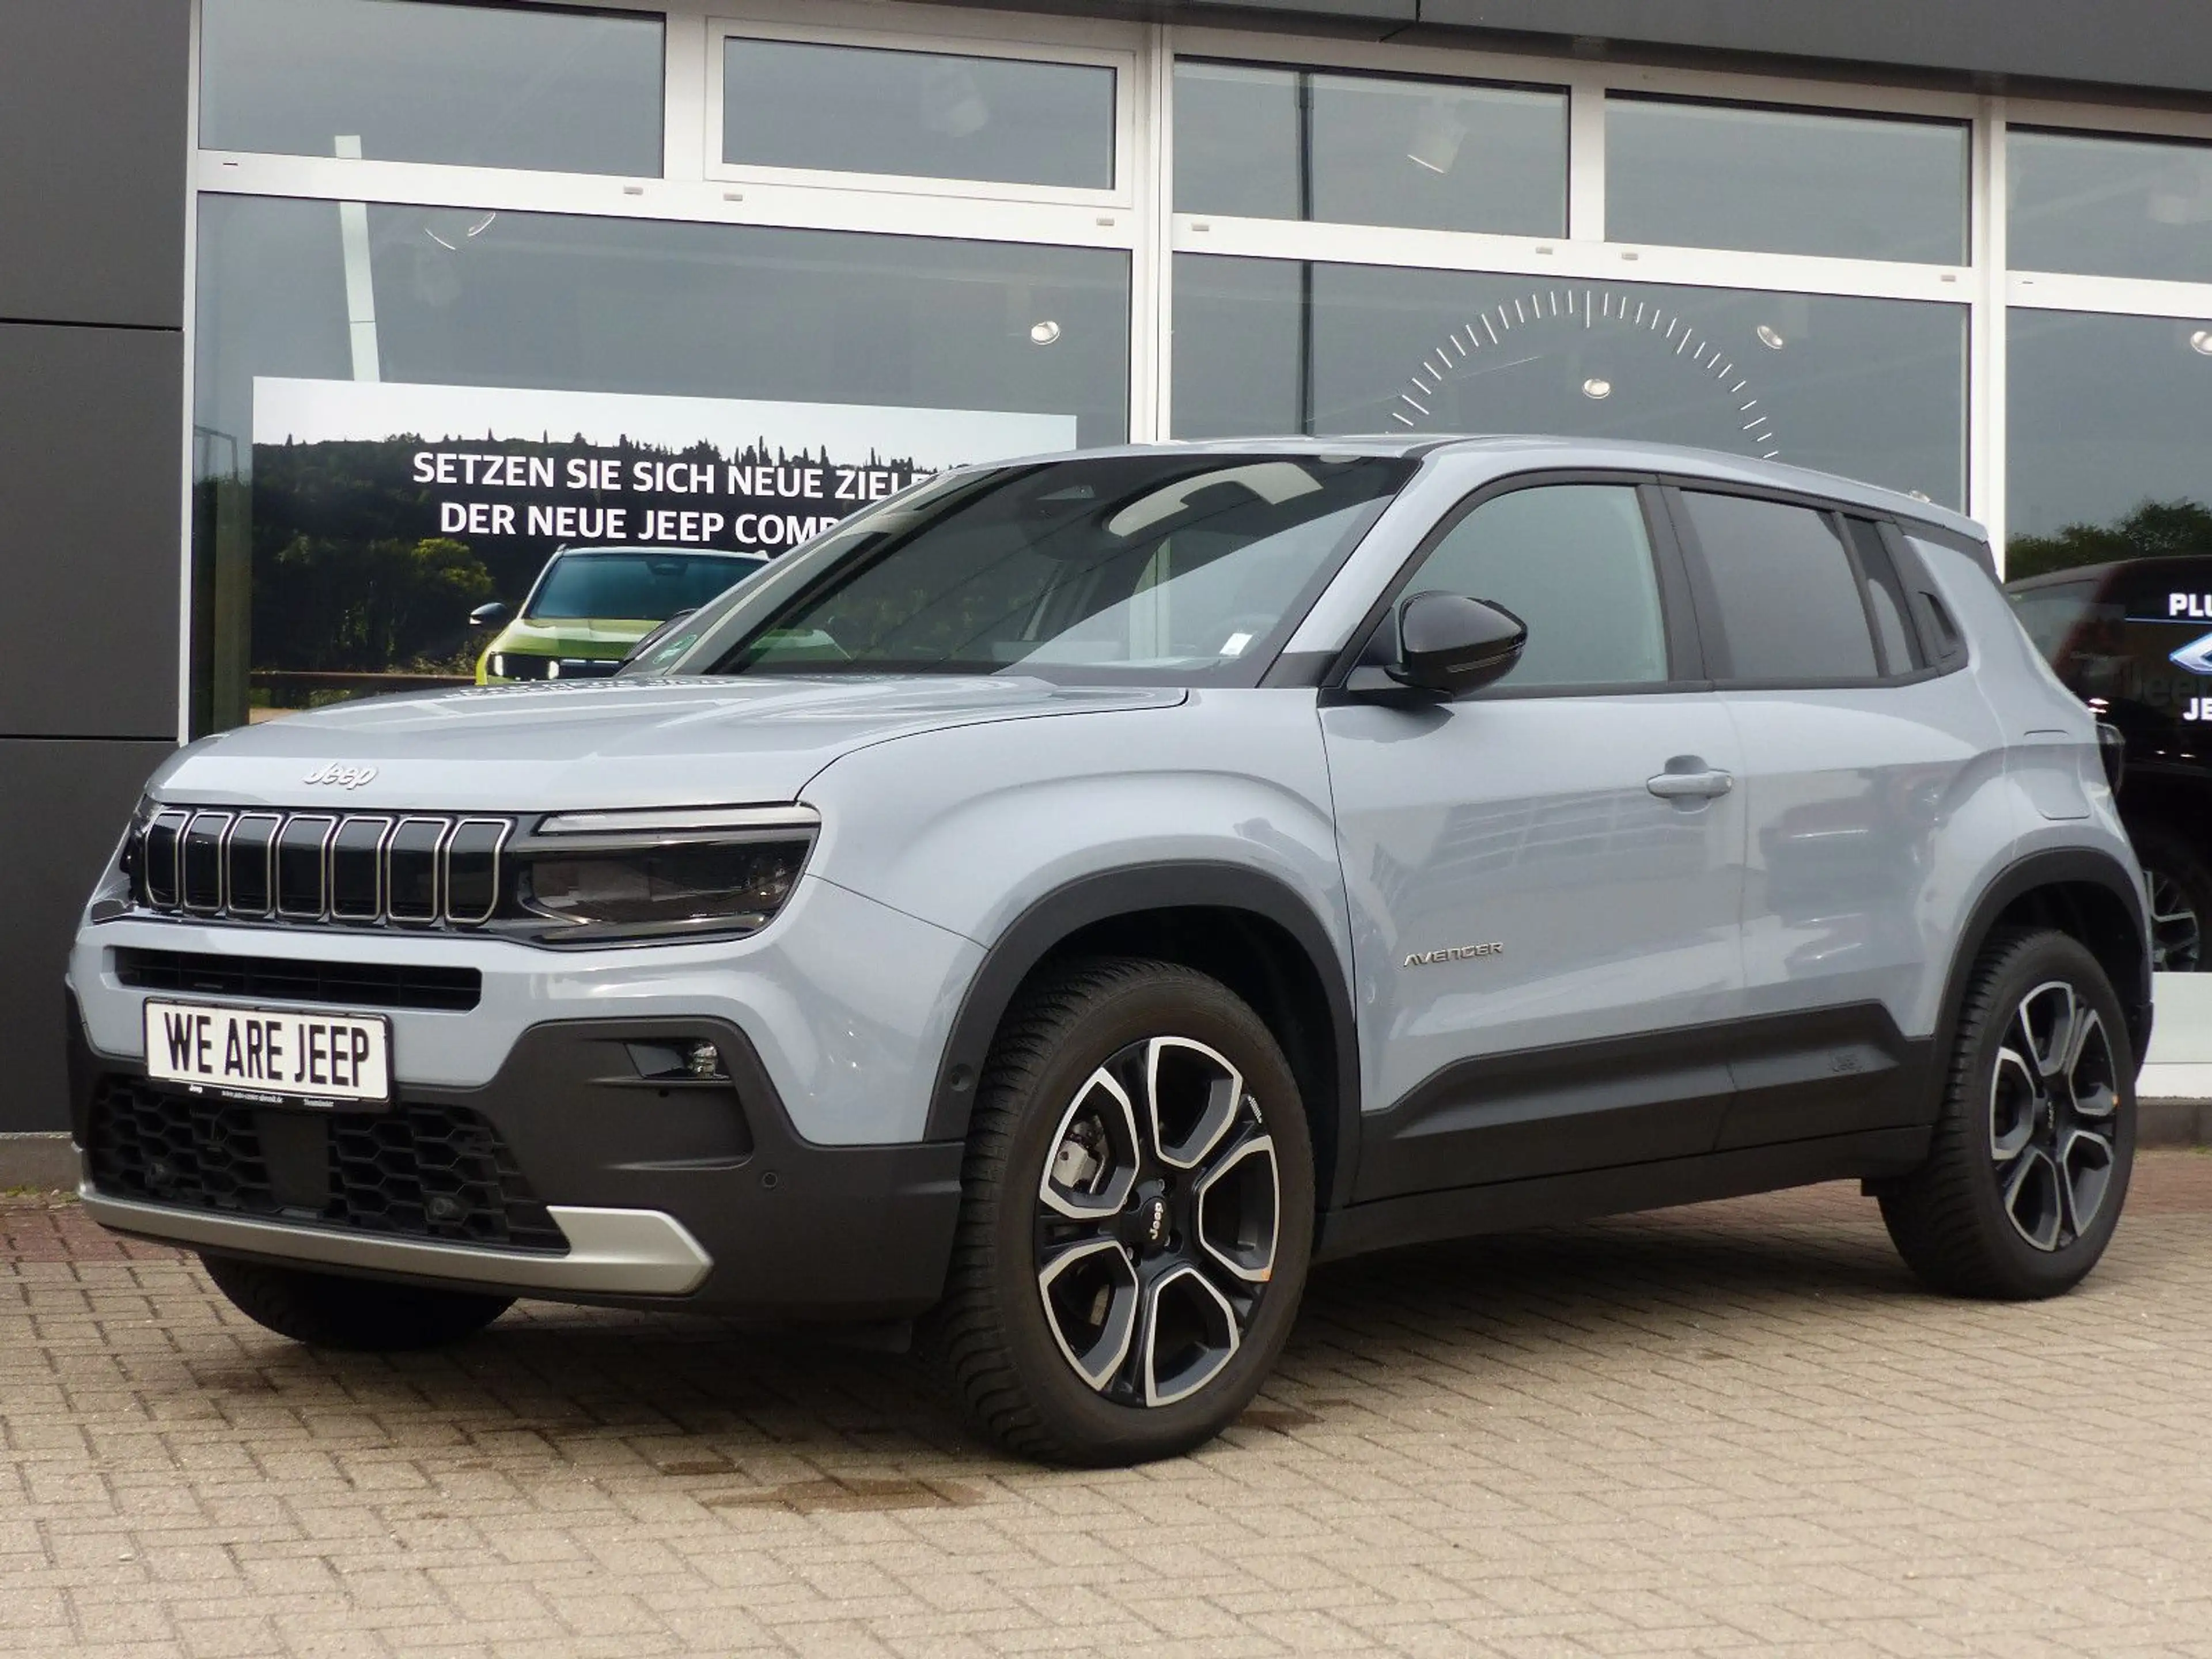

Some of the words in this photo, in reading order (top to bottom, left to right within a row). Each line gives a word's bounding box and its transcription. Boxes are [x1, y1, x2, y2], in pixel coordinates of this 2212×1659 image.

[413, 452, 554, 488] SETZEN
[566, 459, 622, 490] SIE
[632, 461, 715, 494] SICH
[728, 465, 823, 499] NEUE
[441, 502, 516, 535] DER
[528, 506, 627, 539] NEUE
[638, 510, 724, 542] JEEP
[302, 762, 378, 790] Jeep
[1403, 942, 1504, 968] AVENGER
[165, 1012, 213, 1074] WE
[224, 1017, 283, 1081] ARE
[294, 1023, 370, 1088] JEEP
[1149, 1202, 1164, 1240] Jeep
